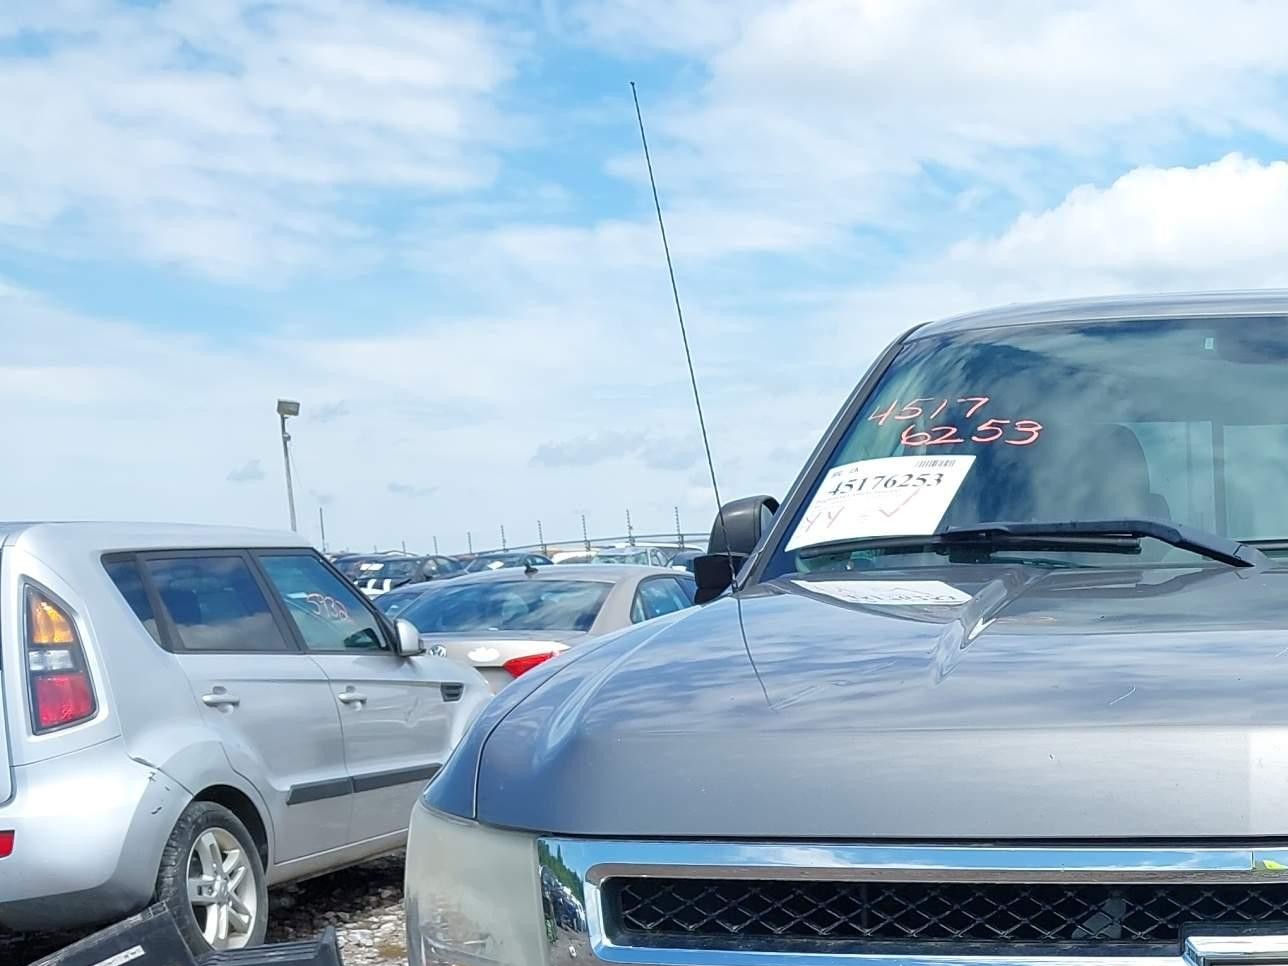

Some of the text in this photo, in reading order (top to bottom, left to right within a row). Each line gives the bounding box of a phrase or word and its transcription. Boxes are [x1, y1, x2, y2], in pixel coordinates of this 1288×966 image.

[868, 397, 990, 426] 4517
[900, 419, 1043, 446] 6253
[828, 473, 945, 496] 45176253
